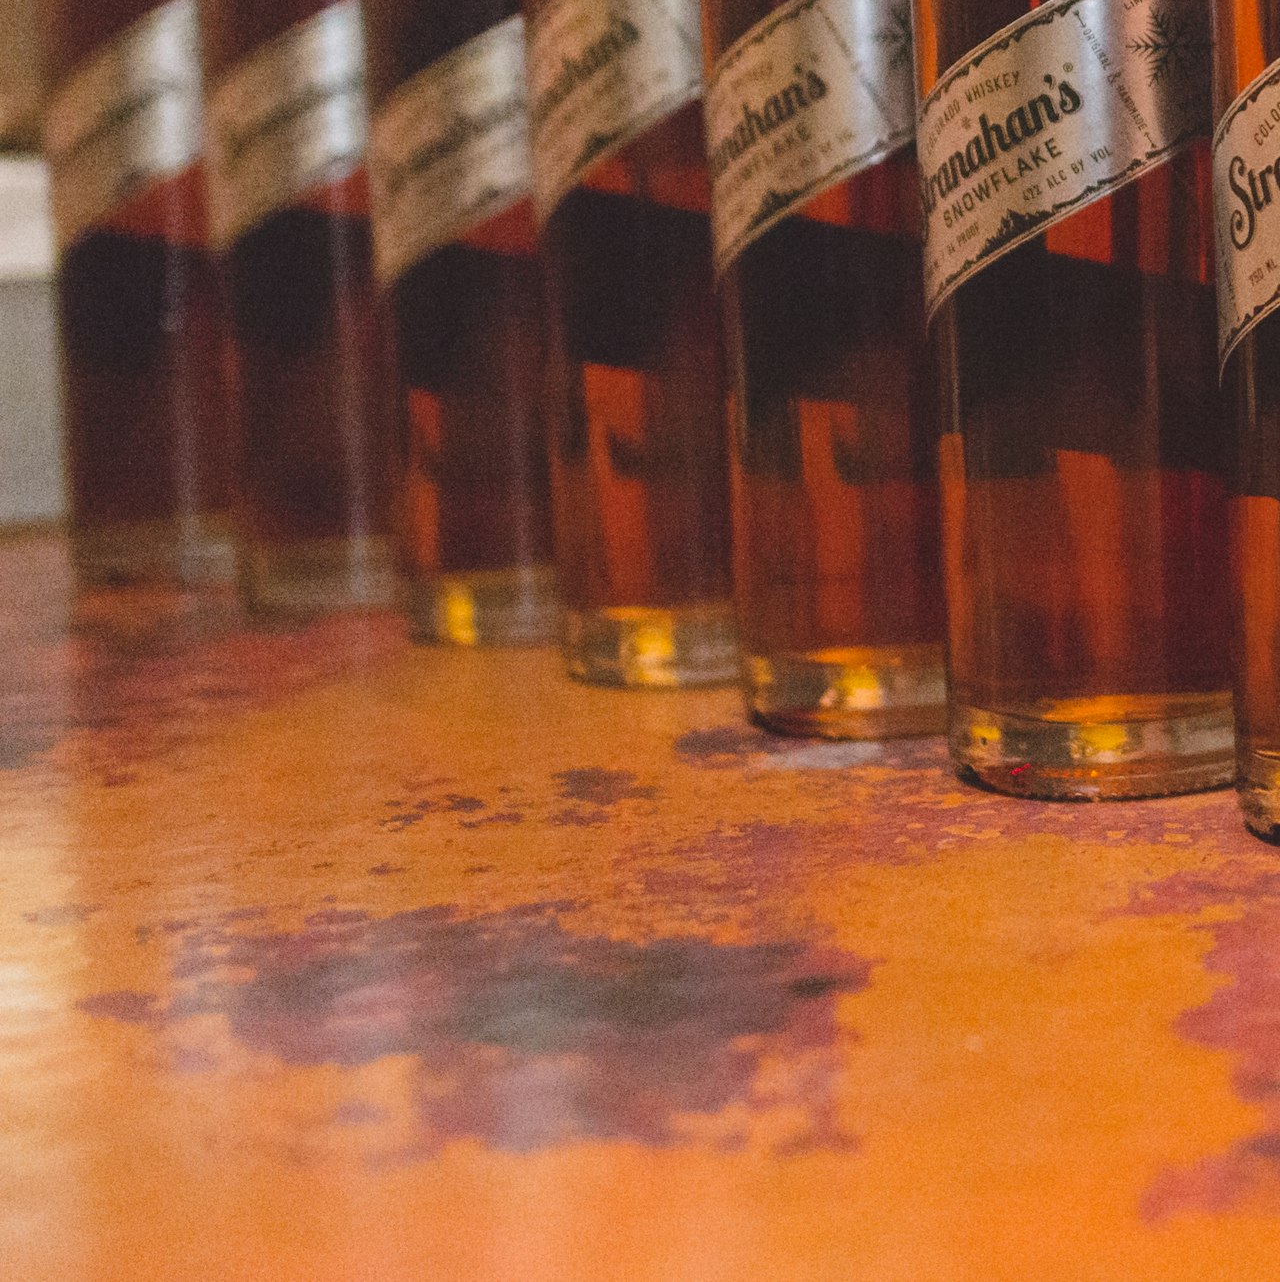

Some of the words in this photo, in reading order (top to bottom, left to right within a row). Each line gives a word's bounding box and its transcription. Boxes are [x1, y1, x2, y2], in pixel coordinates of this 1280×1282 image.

[964, 70, 1021, 104] WHISKEY
[921, 73, 1082, 226] tranahan's
[942, 137, 1063, 230] SNOWFLAKE
[1045, 173, 1068, 190] ALC
[1070, 158, 1085, 175] BY
[1089, 145, 1113, 164] VOL
